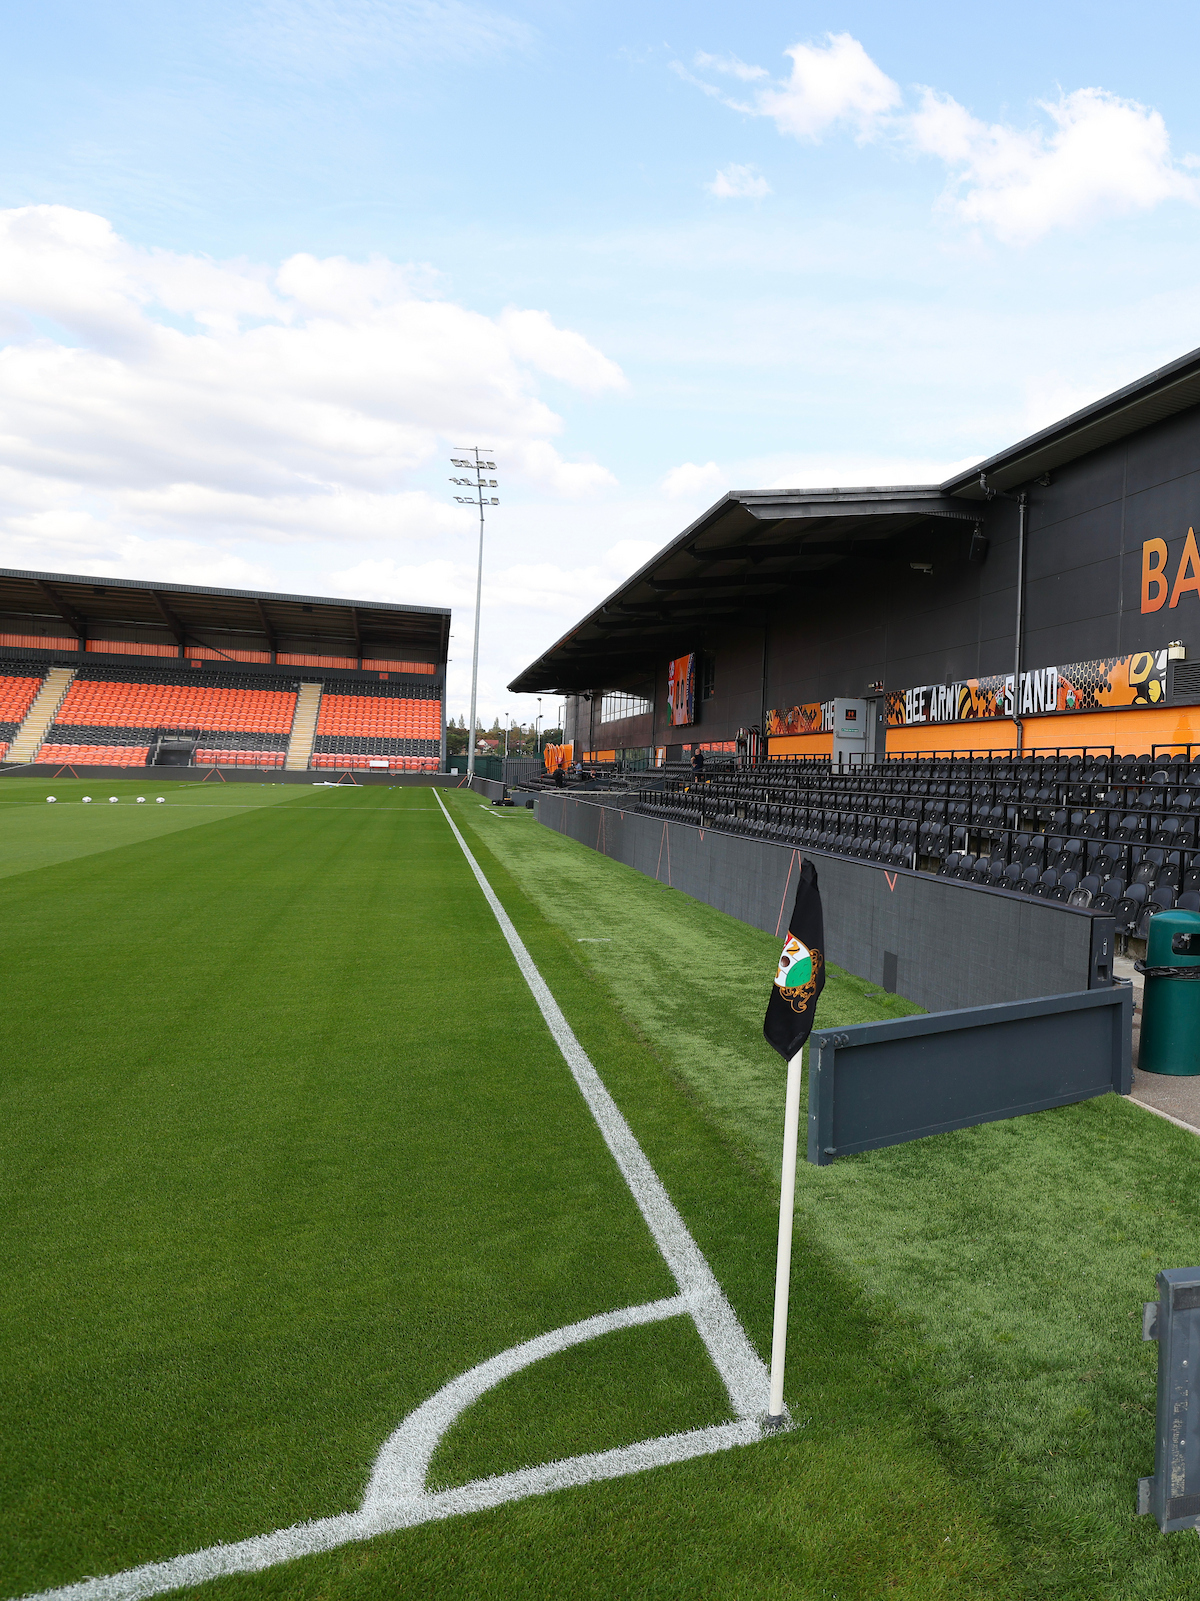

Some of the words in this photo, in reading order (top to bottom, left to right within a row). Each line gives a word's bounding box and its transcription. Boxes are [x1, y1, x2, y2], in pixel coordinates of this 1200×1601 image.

[820, 700, 835, 731] THE
[905, 686, 927, 724] BEE
[930, 684, 962, 722] ARMY
[1004, 666, 1058, 716] STAND
